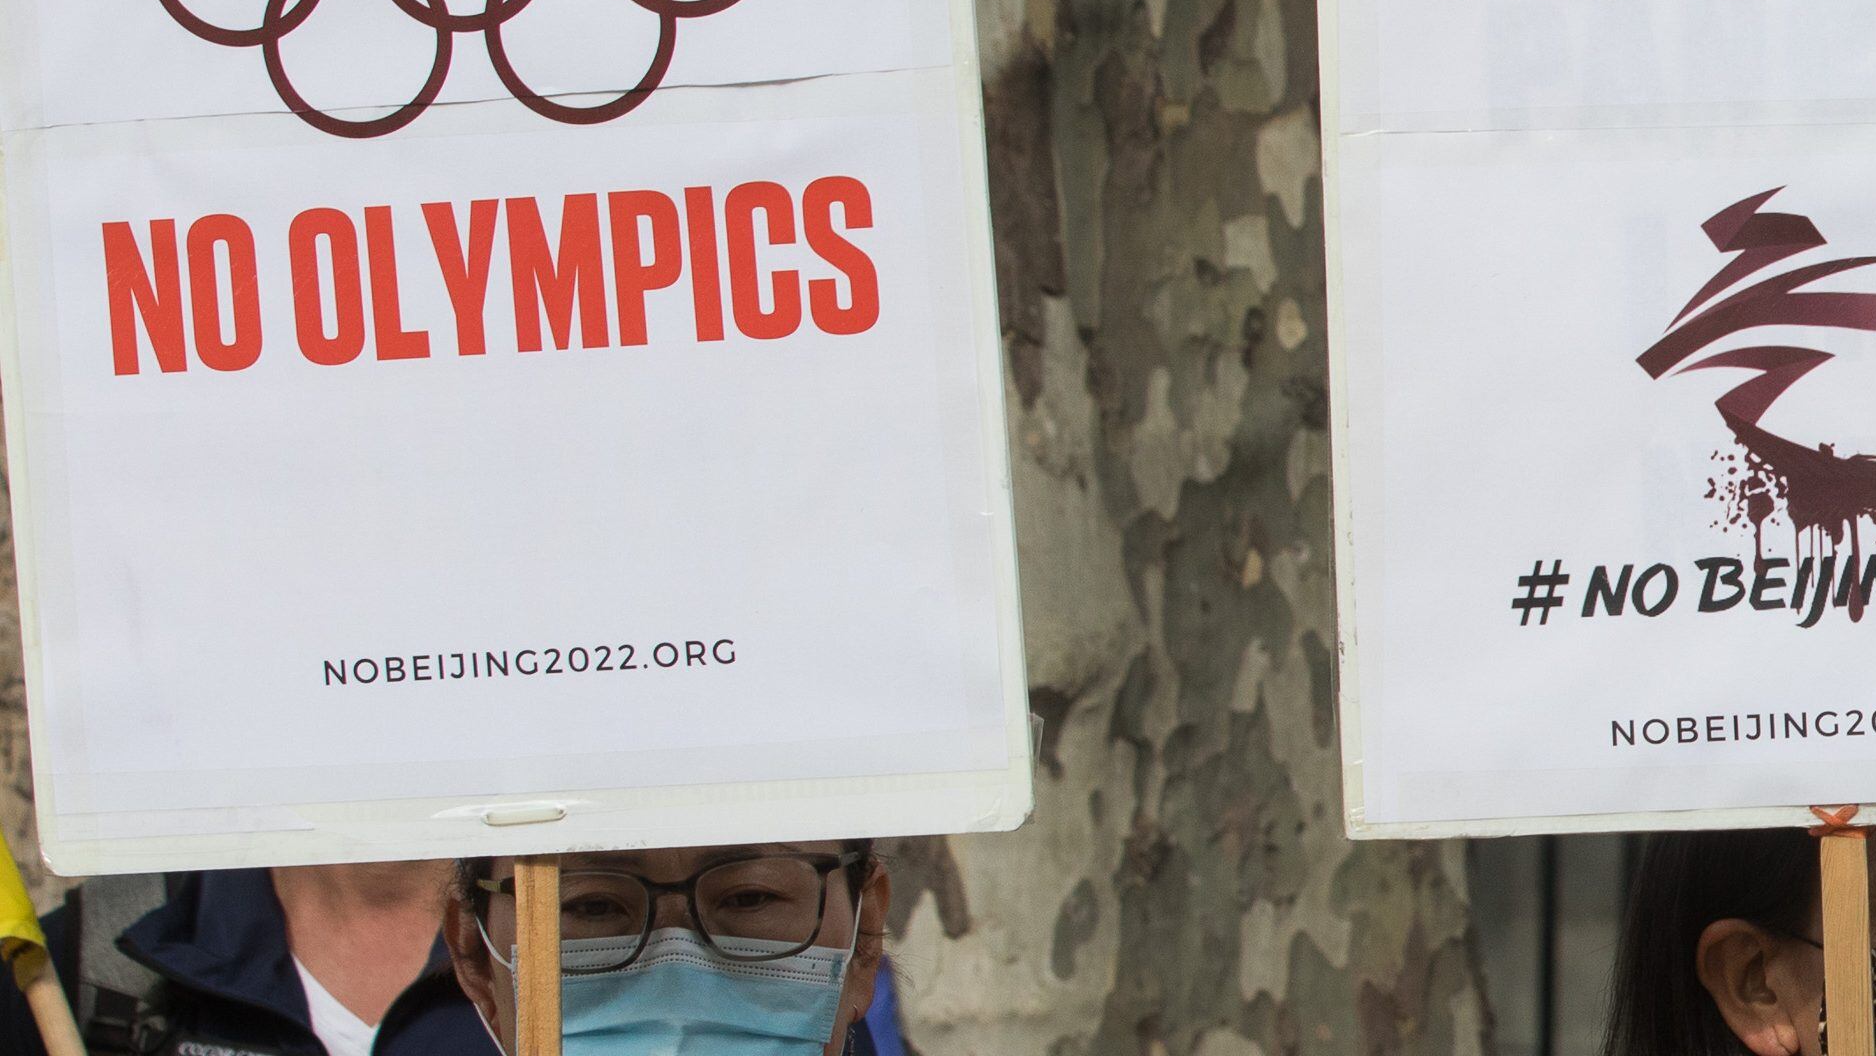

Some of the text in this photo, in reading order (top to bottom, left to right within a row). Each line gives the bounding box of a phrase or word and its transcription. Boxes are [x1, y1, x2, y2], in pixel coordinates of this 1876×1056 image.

[102, 175, 880, 376] NO OLYMPICS
[323, 638, 738, 686] NOBEIJING2022.ORG
